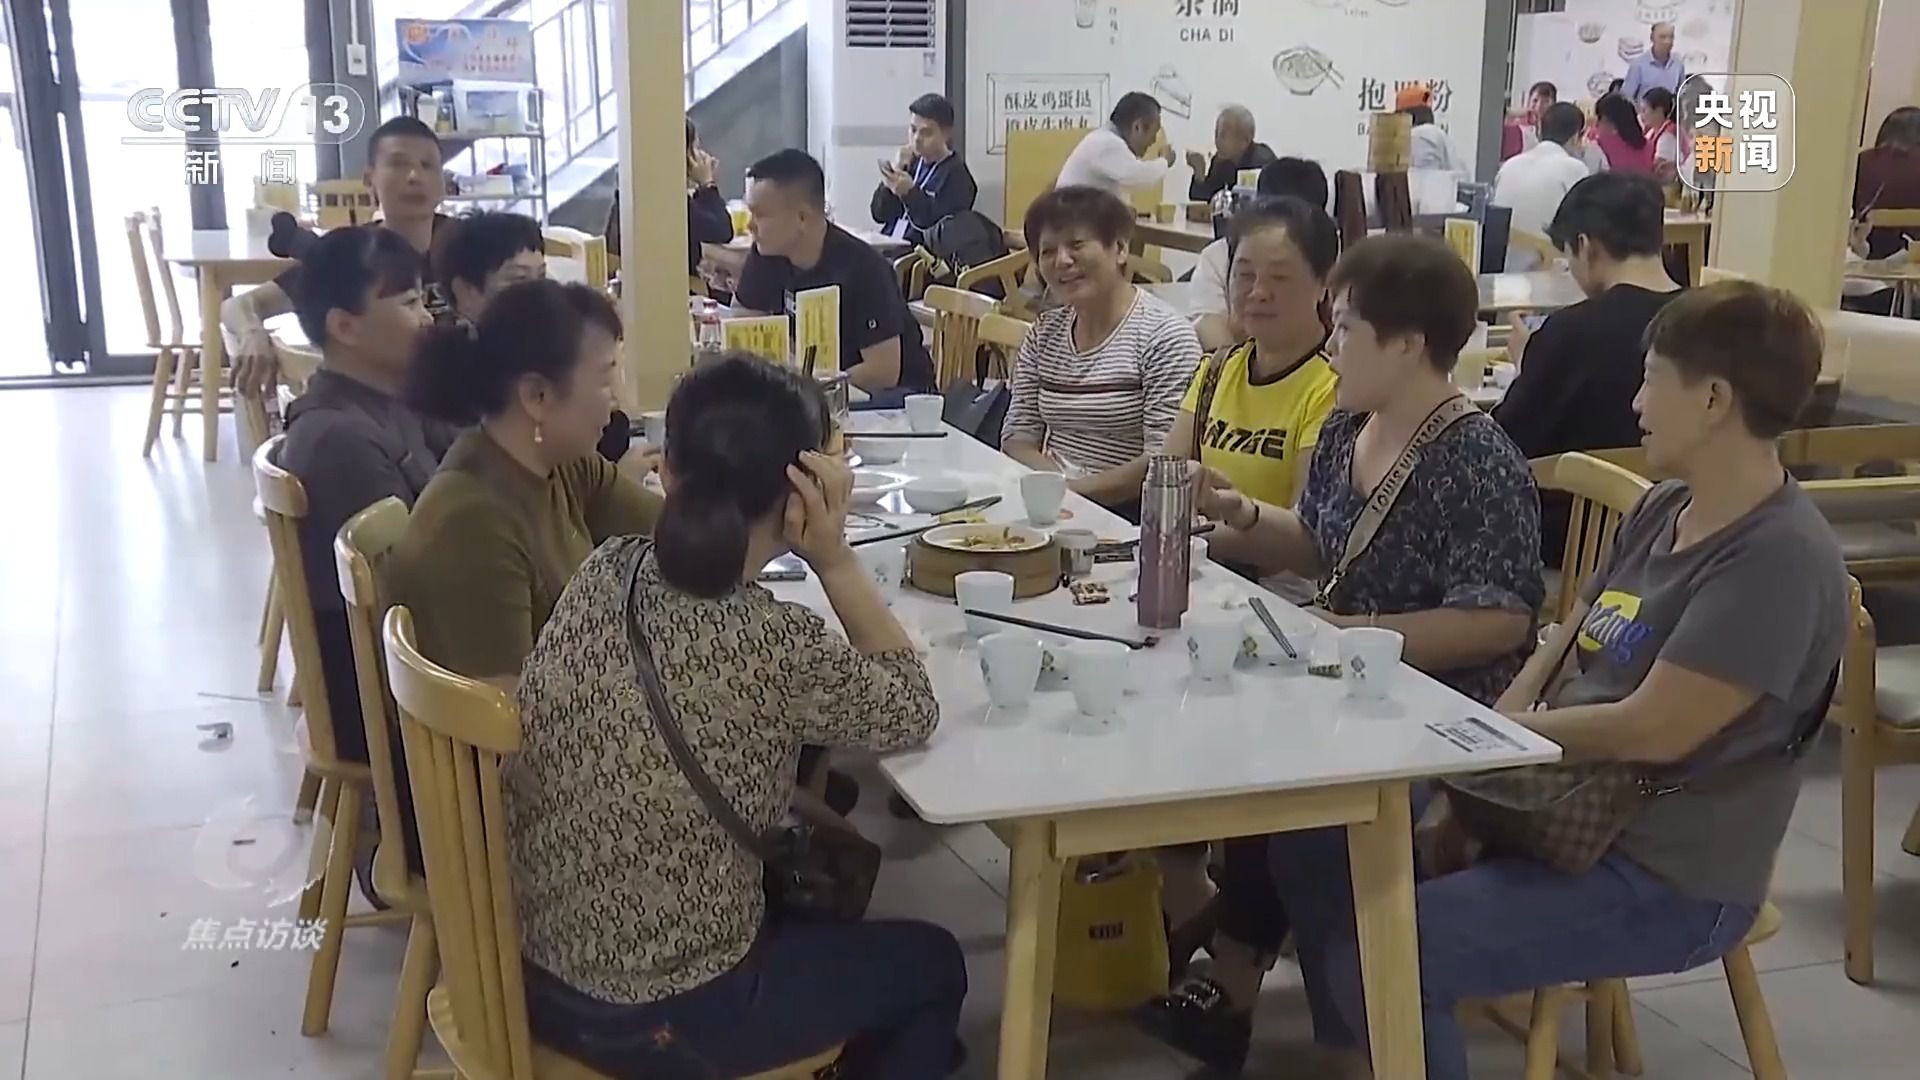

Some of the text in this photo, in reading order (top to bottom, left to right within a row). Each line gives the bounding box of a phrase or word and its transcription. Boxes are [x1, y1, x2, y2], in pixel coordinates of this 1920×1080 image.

[1179, 28, 1234, 42] CHA DI
[1358, 77, 1453, 112] 抱粉
